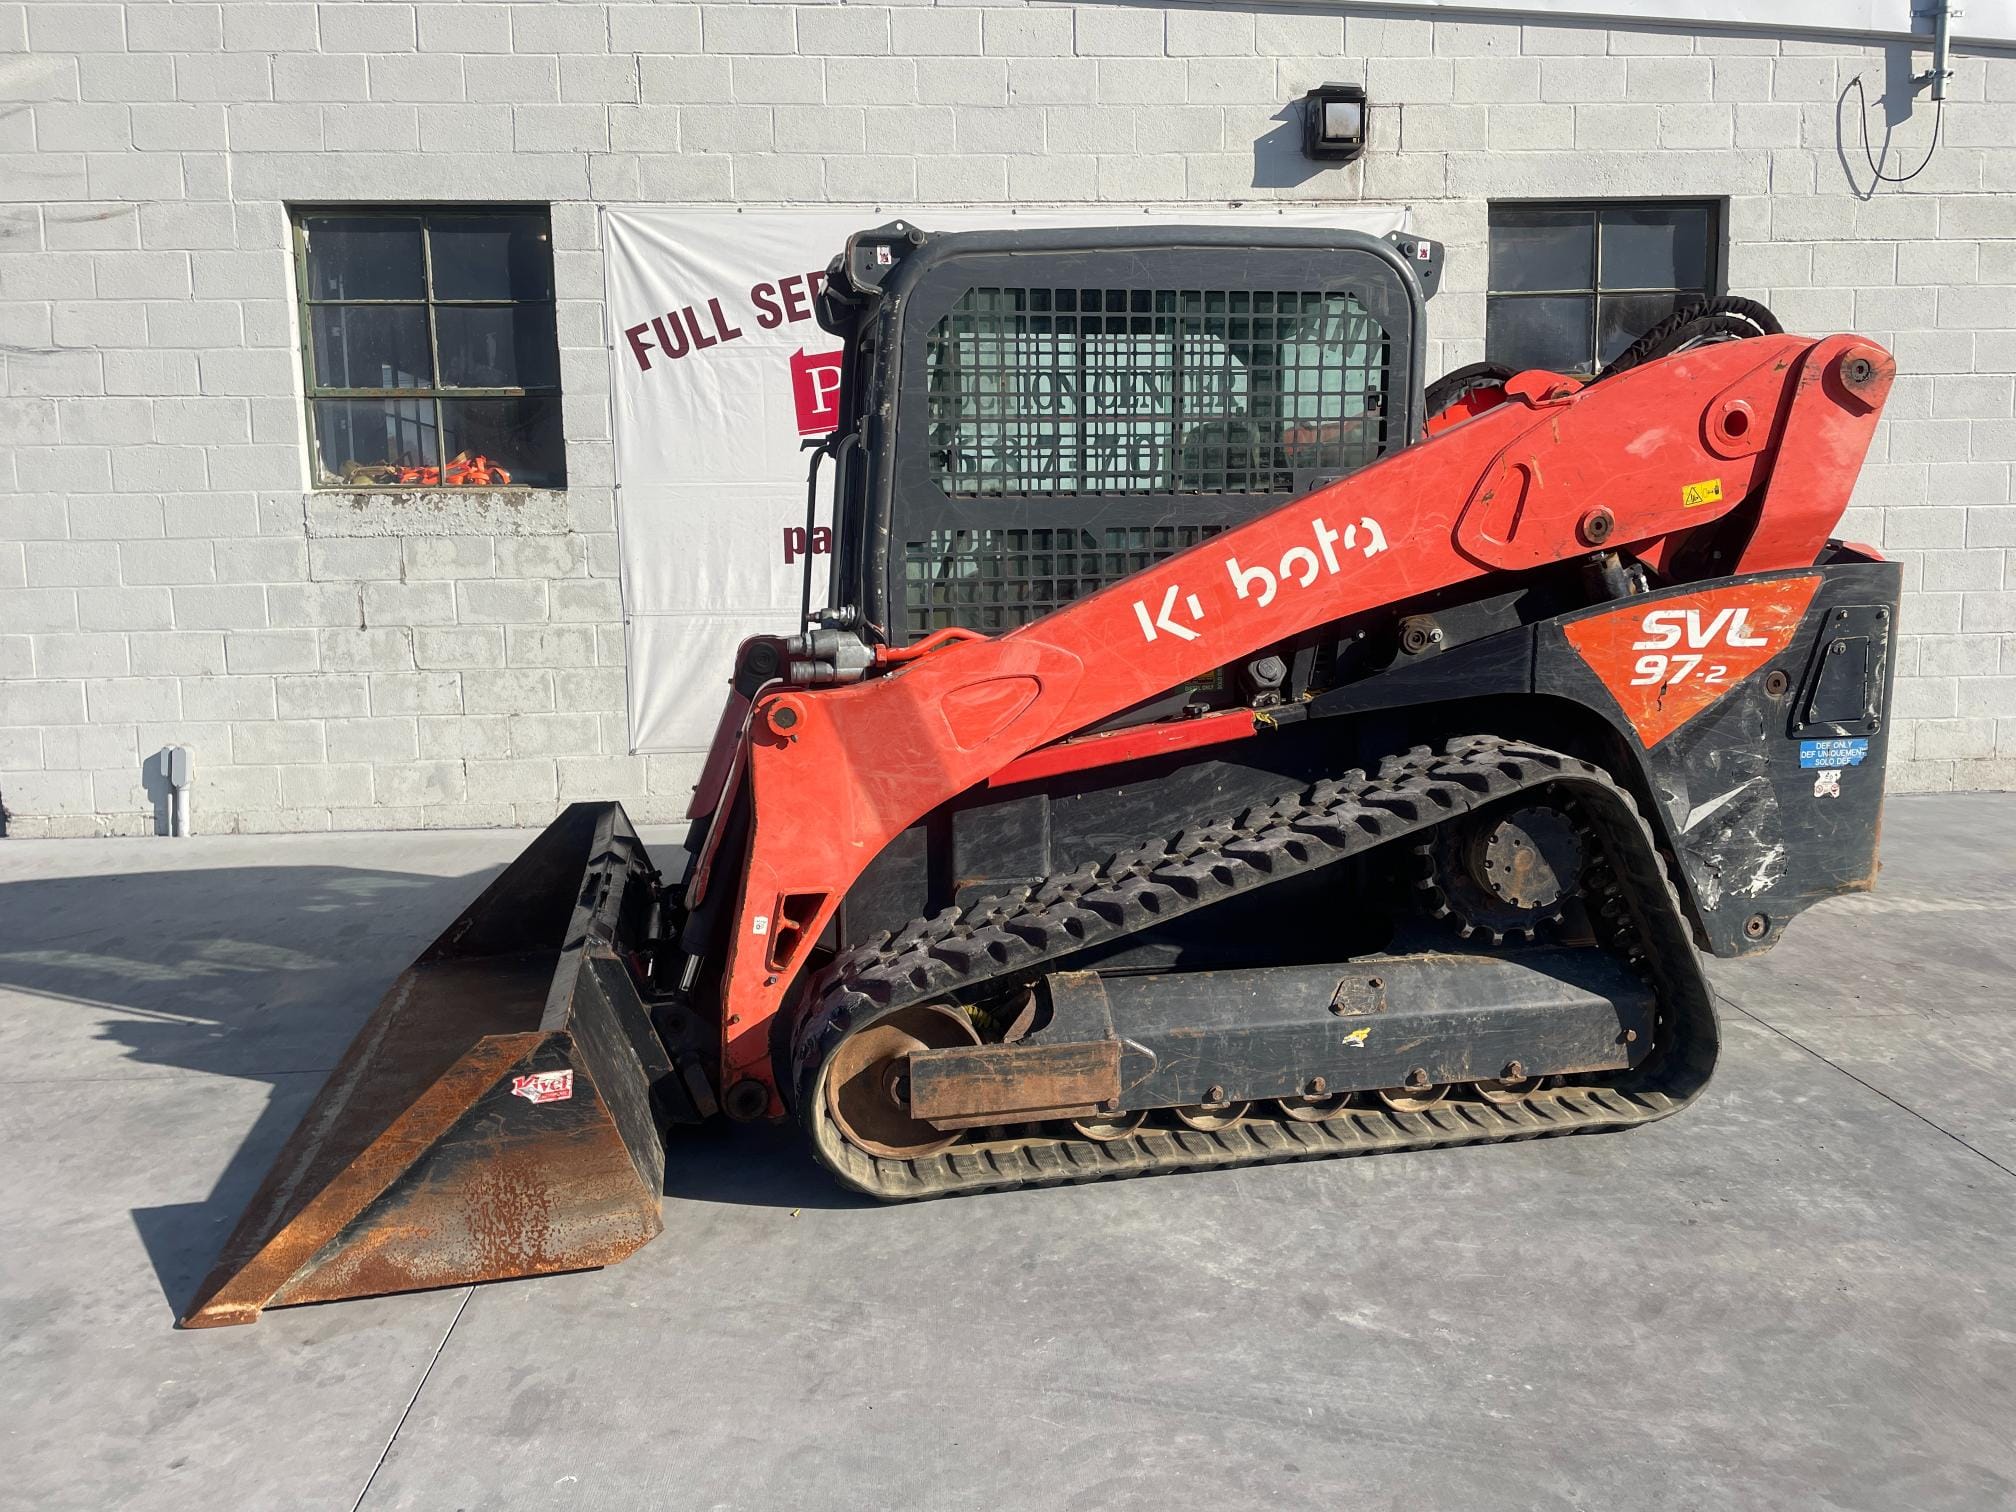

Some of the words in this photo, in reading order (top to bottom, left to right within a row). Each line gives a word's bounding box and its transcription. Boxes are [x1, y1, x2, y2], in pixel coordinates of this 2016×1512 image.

[625, 298, 743, 372] FULL
[1632, 607, 1769, 651] SVL
[1630, 653, 1727, 686] 97-2
[1801, 751, 1815, 759] DEF
[1816, 742, 1831, 750] DEF
[1833, 741, 1853, 749] ONLY
[1815, 758, 1834, 766] SOLO
[1836, 757, 1852, 765] DEF
